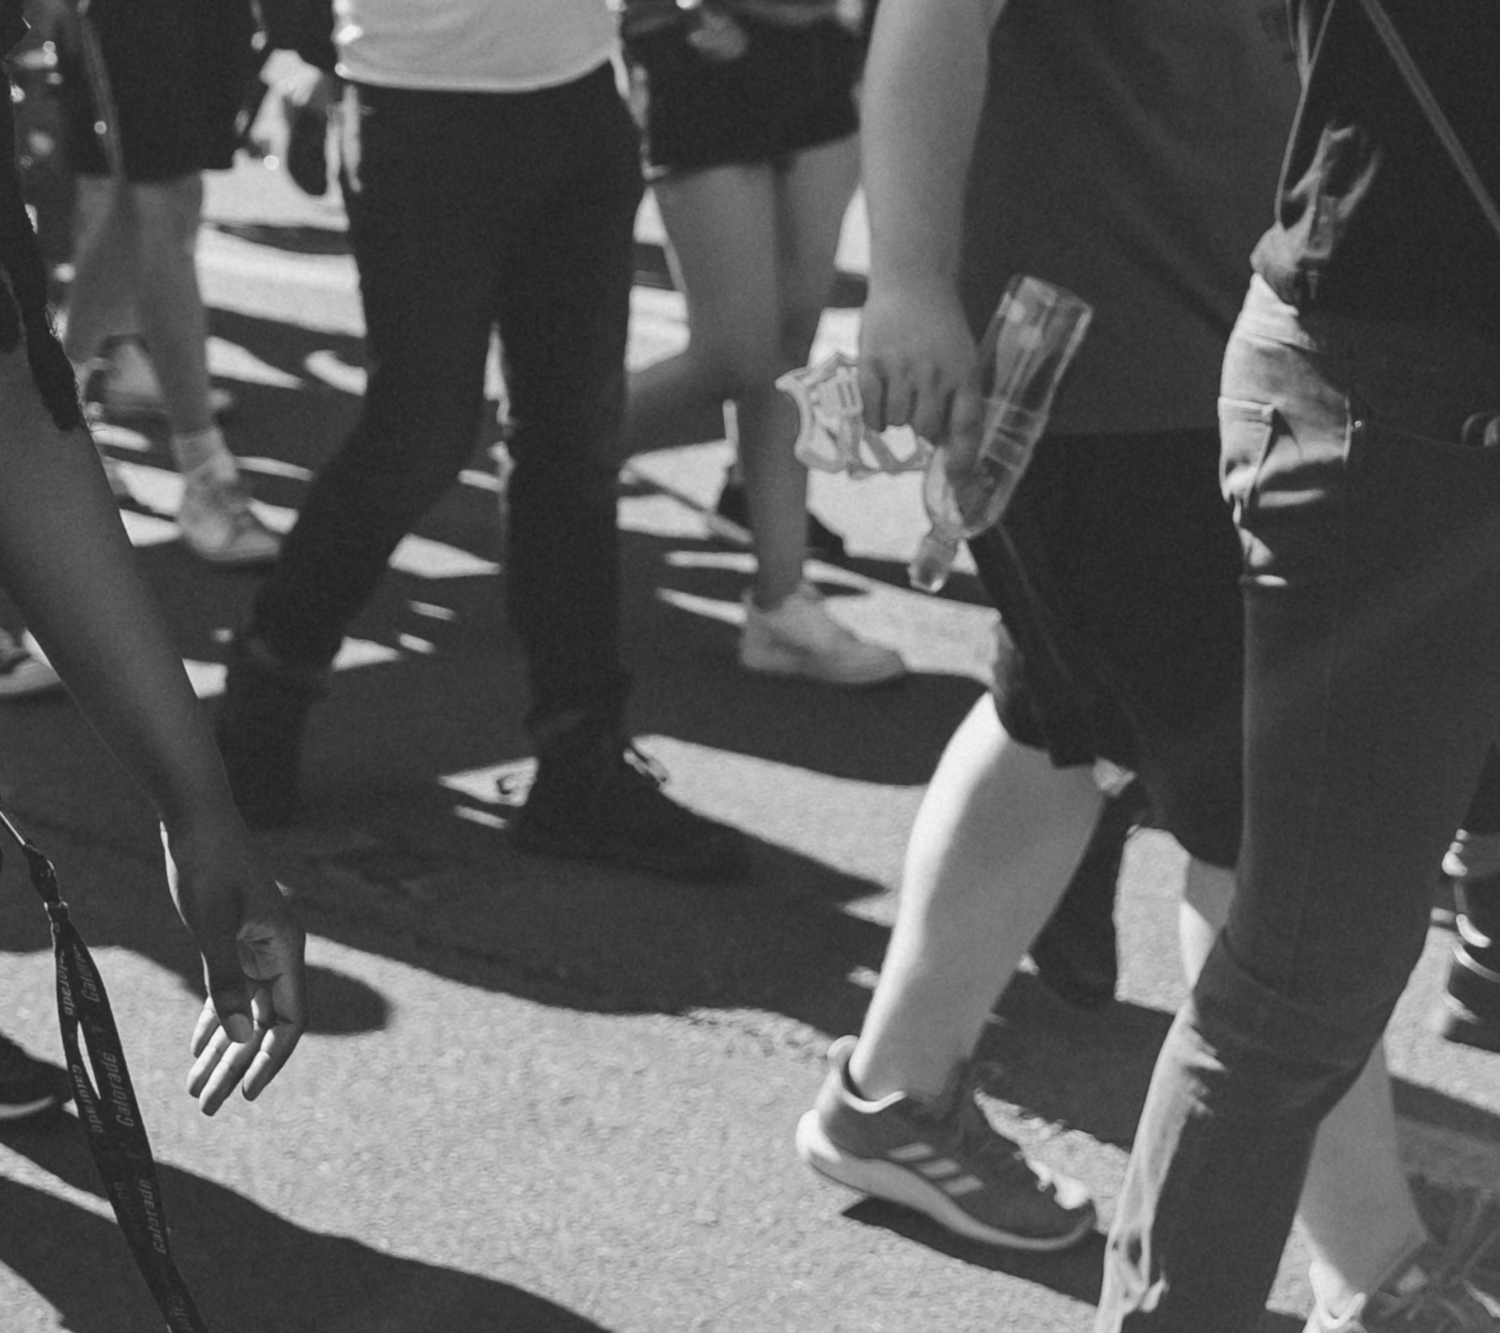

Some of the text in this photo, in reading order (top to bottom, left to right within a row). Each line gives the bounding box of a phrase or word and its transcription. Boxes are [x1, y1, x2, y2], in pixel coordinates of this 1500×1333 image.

[71, 1063, 104, 1133] Gatorade
[101, 1051, 135, 1129] Gatorade
[137, 1178, 167, 1255] Gatorade
